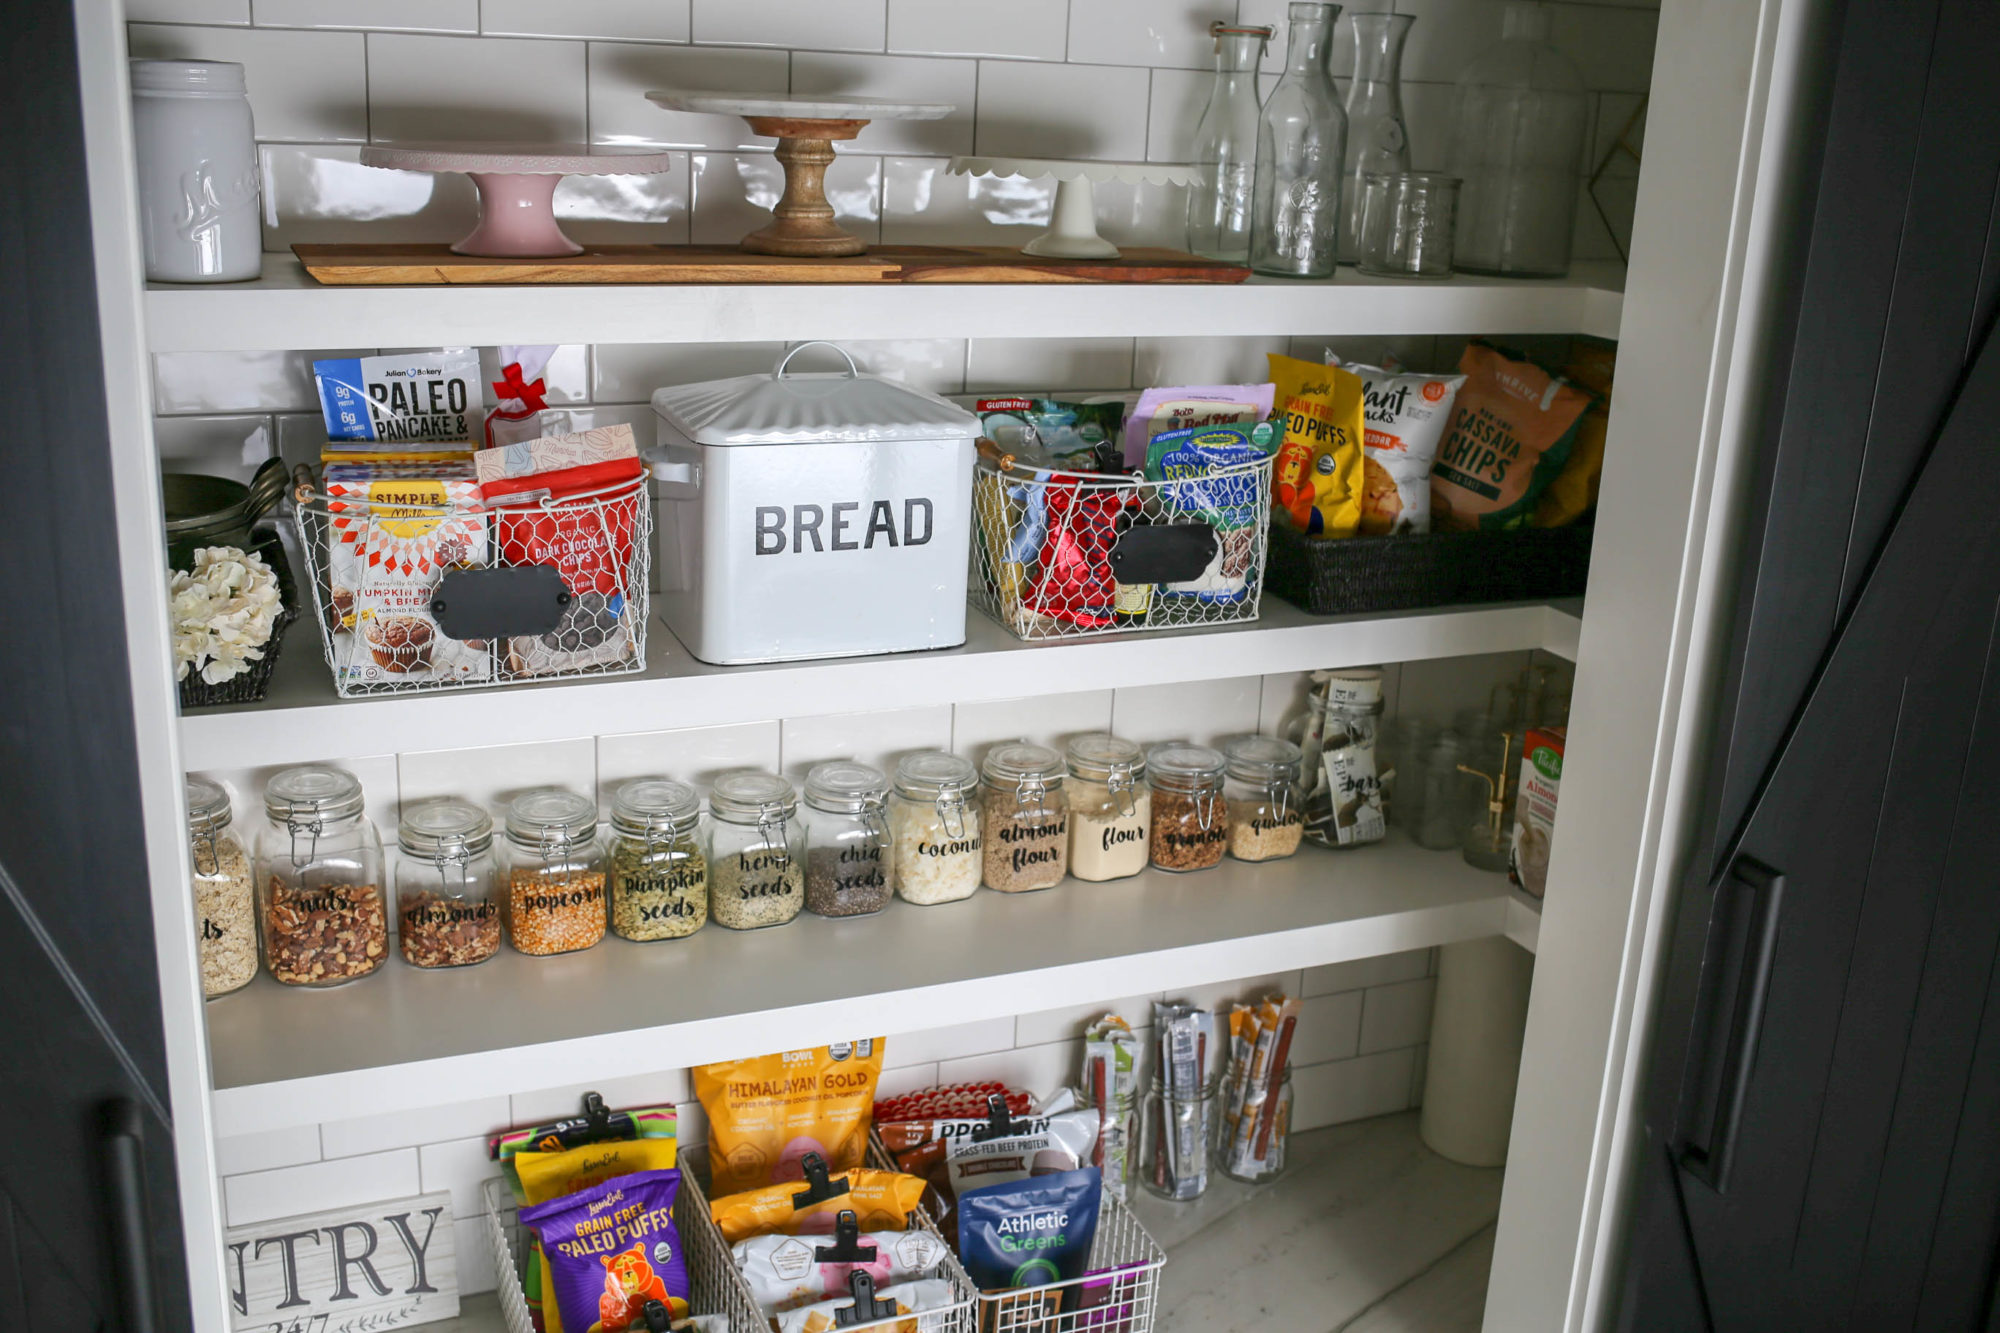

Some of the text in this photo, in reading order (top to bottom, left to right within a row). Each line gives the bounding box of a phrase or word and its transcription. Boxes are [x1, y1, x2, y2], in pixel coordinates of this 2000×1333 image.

[385, 368, 442, 377] Julian Bakery
[335, 387, 350, 399] 9g
[368, 377, 468, 420] PALEO
[986, 400, 1030, 409] GLUTEN FREE
[1363, 381, 1412, 416] lant
[341, 412, 356, 424] 6g
[375, 414, 468, 442] PANCAKE &
[1364, 409, 1395, 424] acks
[1305, 417, 1346, 446] PUFFS
[1455, 407, 1521, 459] CASSAVA
[1169, 451, 1258, 464] 100% ORGANIC
[1441, 431, 1512, 483] CHIPS
[375, 493, 440, 505] SIMPLE
[755, 497, 934, 556] BREAD
[535, 534, 617, 559] DARK CHOCOLAE
[562, 552, 592, 567] CHIPS
[1346, 774, 1382, 792] bars
[1526, 779, 1558, 805] Almon
[999, 814, 1067, 844] almond
[1101, 826, 1145, 852] flour
[739, 853, 792, 872] hemp
[839, 844, 883, 864] chia
[1012, 846, 1061, 874] flour
[624, 870, 705, 896] pumpkin
[739, 875, 793, 900] seeds
[835, 867, 886, 892] seeds
[299, 889, 348, 915] nuts
[407, 898, 496, 926] almonds
[523, 886, 601, 916] popcorn
[640, 900, 695, 922] seeds
[199, 917, 223, 940] ts
[782, 1050, 814, 1063] BOWL
[728, 1071, 868, 1098] HIMALAYAN GOLD
[954, 1138, 1049, 1158] GRASS-FED BEEF PROTEIN
[574, 1201, 647, 1238] GRAIN FREE
[997, 1210, 1069, 1234] Athletic
[558, 1207, 670, 1259] PALEO PUFFS
[1000, 1232, 1067, 1253] Greens
